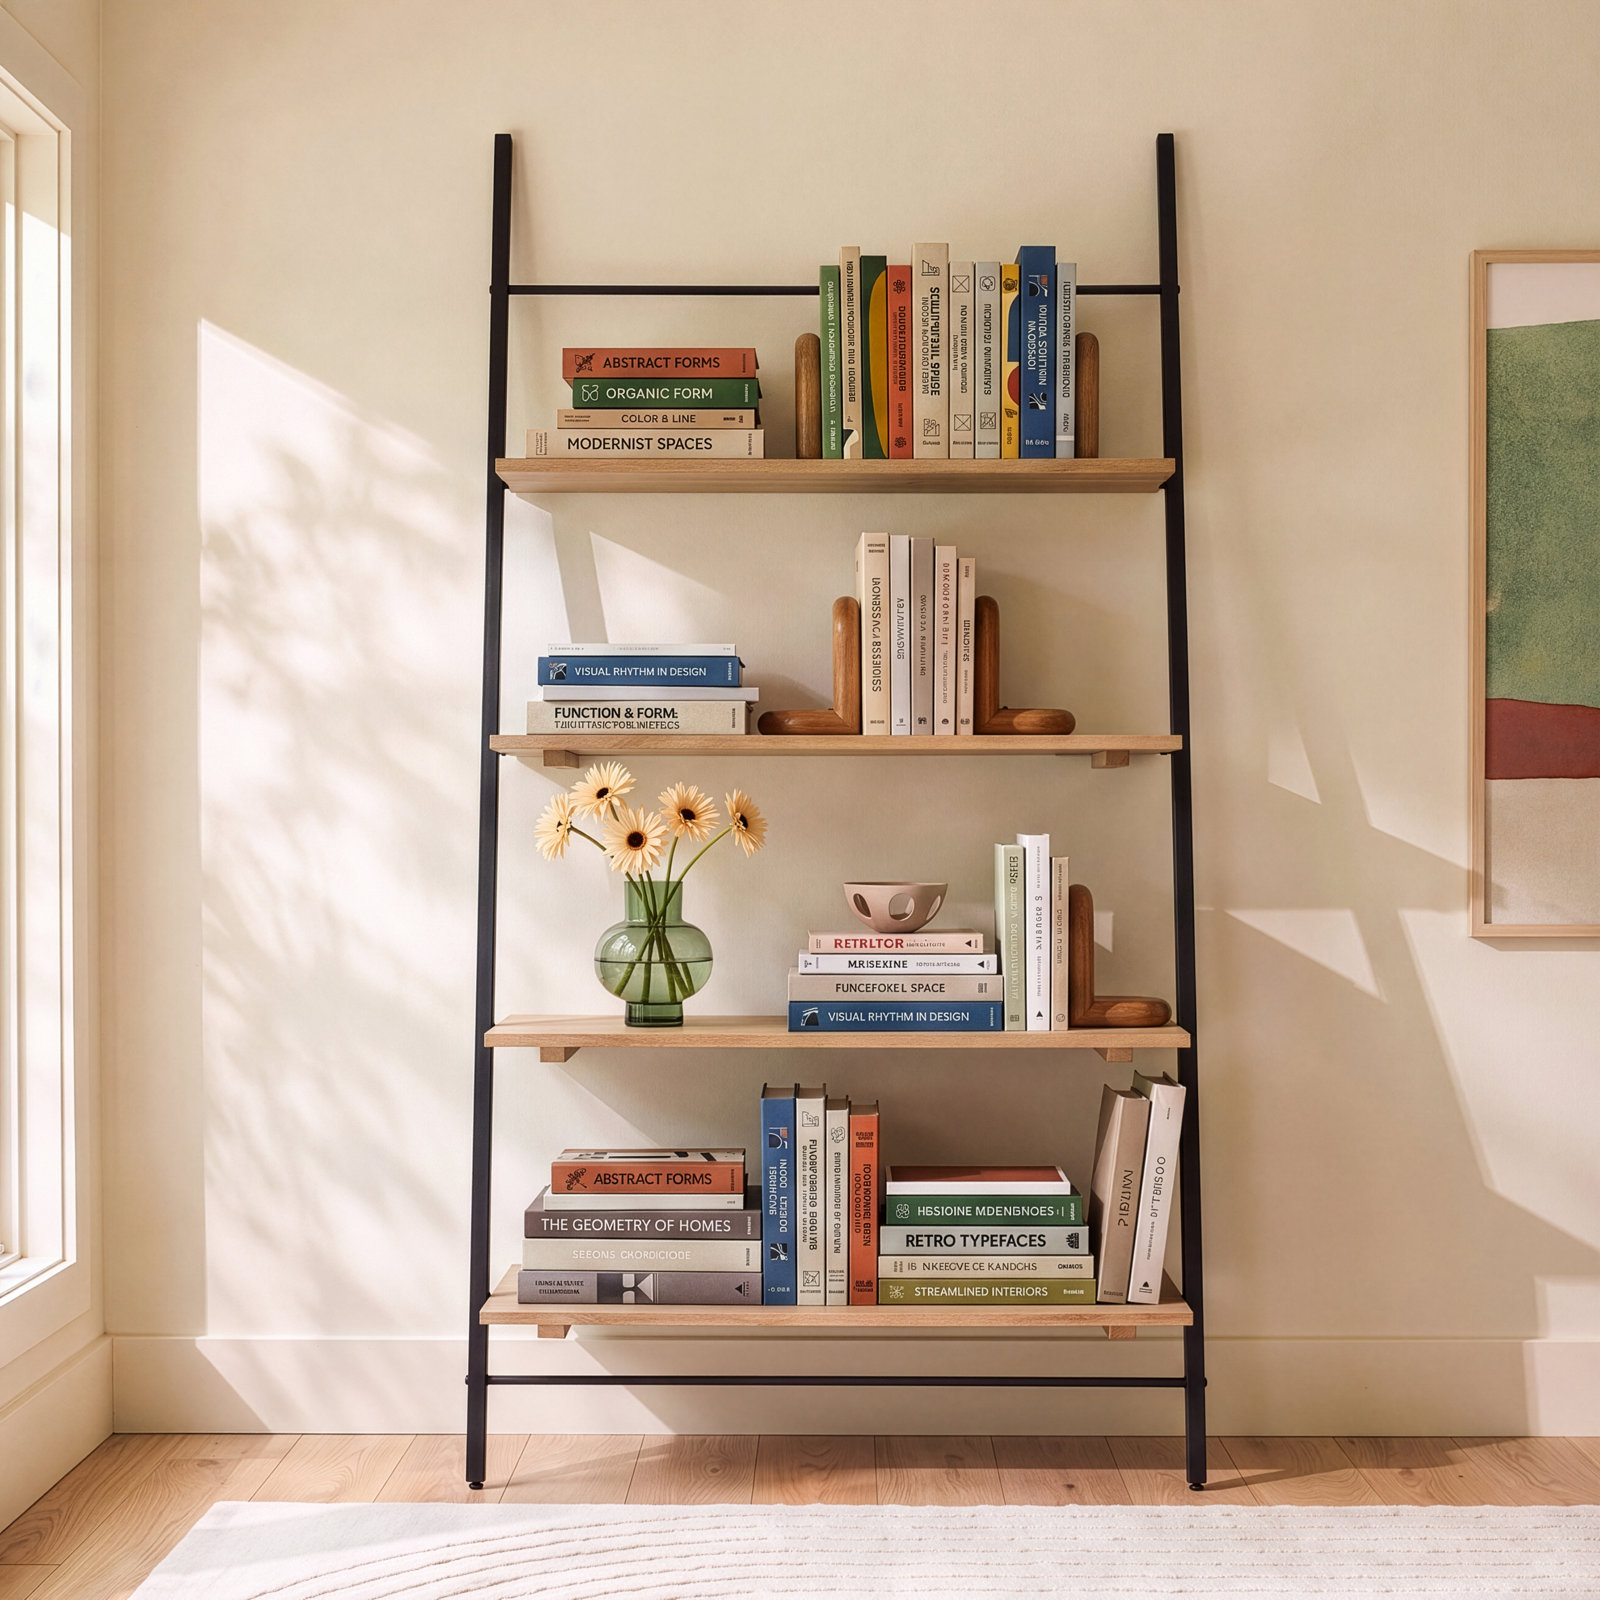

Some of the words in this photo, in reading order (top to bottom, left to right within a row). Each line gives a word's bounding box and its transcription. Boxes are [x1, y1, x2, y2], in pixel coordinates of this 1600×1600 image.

[603, 357, 671, 369] ABSTRACT
[674, 357, 721, 369] FORMS
[606, 387, 670, 399] ORGANIC
[674, 387, 713, 399] FORM
[621, 414, 658, 423] COLOR
[672, 414, 696, 423] LINE
[567, 437, 653, 450] MODERNIST
[657, 437, 713, 450] SPACES
[575, 667, 611, 676] VISUAL
[613, 667, 655, 676] RHYTHM
[657, 667, 667, 676] IN
[670, 667, 707, 677] DESIGN
[554, 707, 621, 719] FUNCTION
[624, 707, 634, 719] &
[834, 938, 904, 948] RETRLTOR
[911, 983, 945, 993] SPACE
[828, 1012, 865, 1022] VISUAL
[868, 1012, 913, 1022] RHYTHM
[916, 1012, 927, 1022] IN
[930, 1012, 970, 1022] DESIGN
[594, 1173, 662, 1185] ABSTRACT
[666, 1173, 712, 1185] FORMS
[541, 1218, 568, 1231] THE
[572, 1218, 651, 1231] GEOMETRY
[654, 1219, 674, 1232] OF
[679, 1219, 731, 1232] HOMES
[905, 1234, 956, 1248] RETRO
[960, 1234, 1047, 1248] TYPEFACES
[914, 1287, 989, 1297] STREAMLINED
[992, 1287, 1048, 1297] INTERIORS
